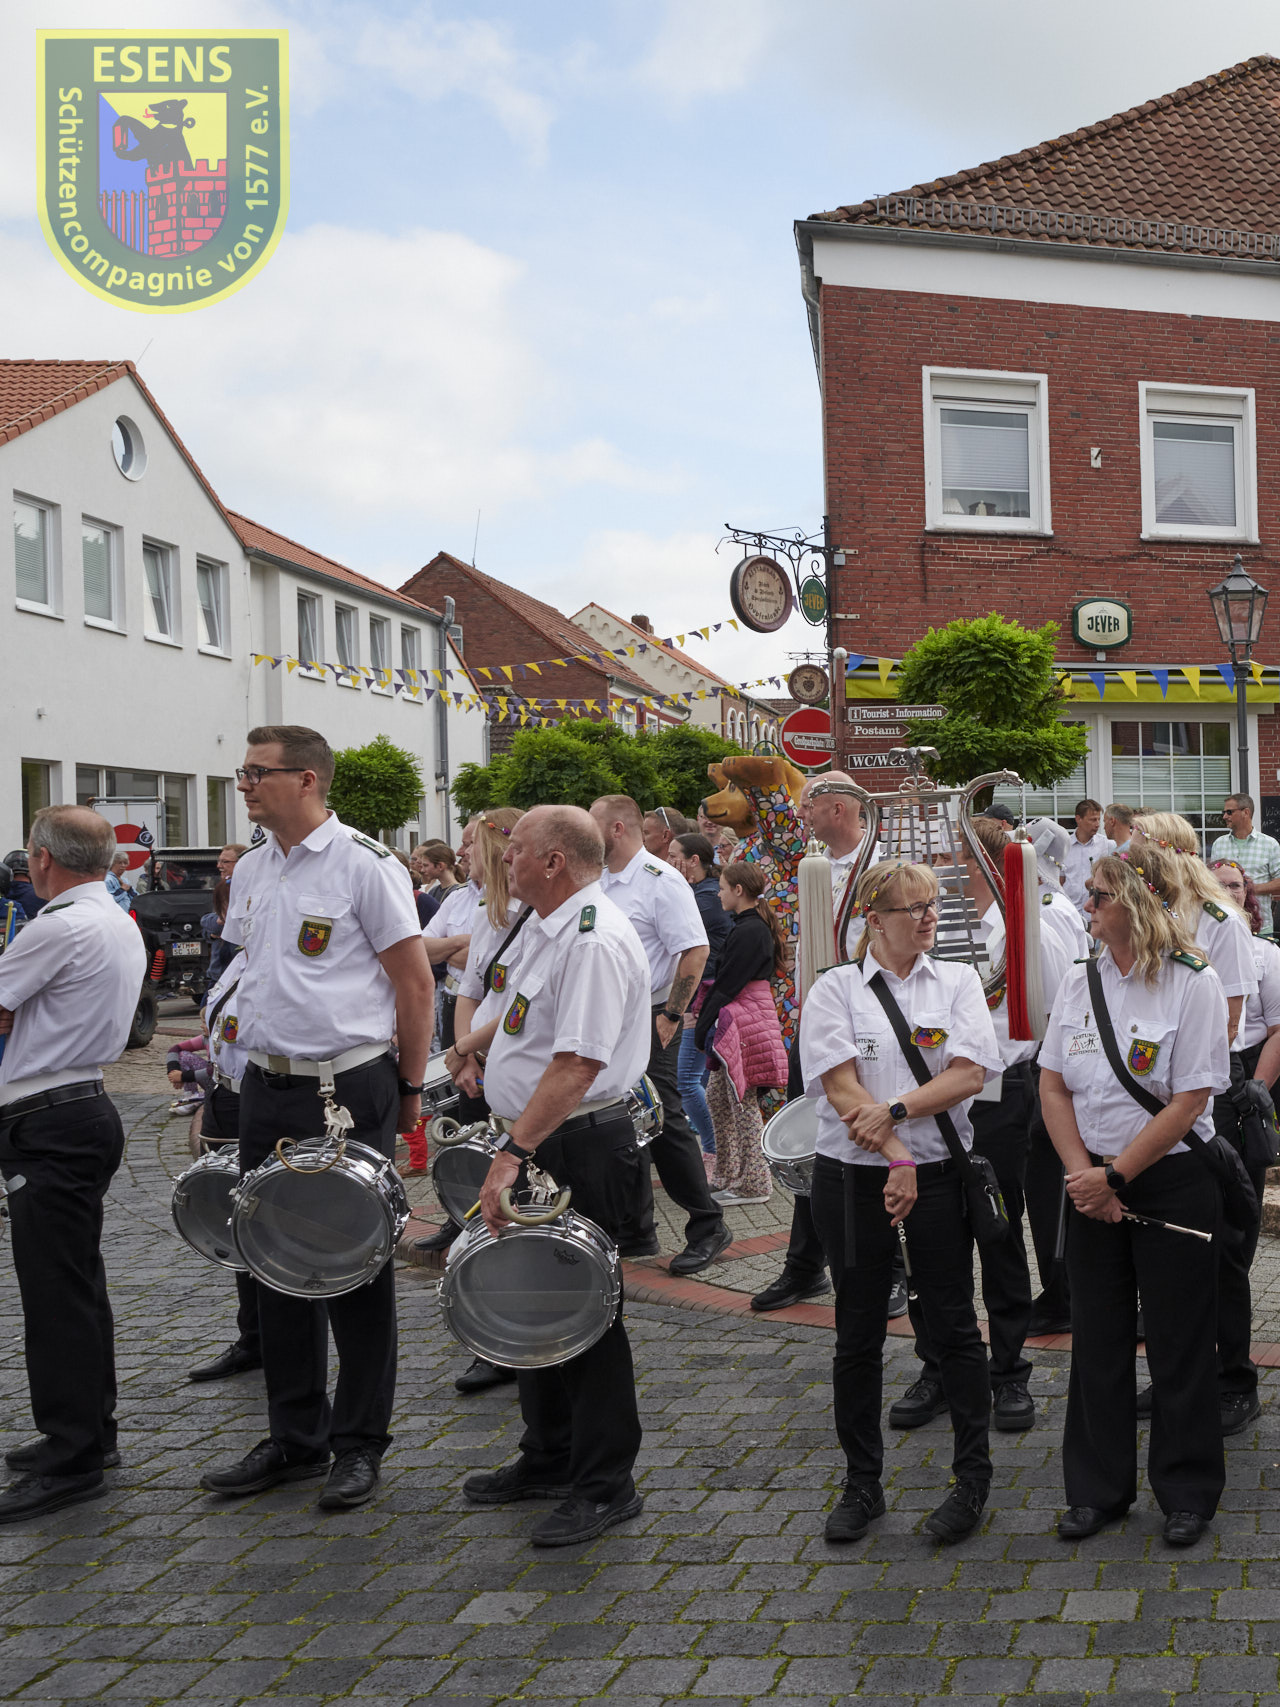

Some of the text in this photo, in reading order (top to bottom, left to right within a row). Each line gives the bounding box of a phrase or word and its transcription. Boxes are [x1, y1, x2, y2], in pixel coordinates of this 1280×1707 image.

[804, 593, 825, 610] JEVER
[1087, 615, 1120, 633] JEVER
[861, 709, 889, 719] Tourist
[896, 708, 942, 717] Information
[854, 725, 900, 736] Postamt
